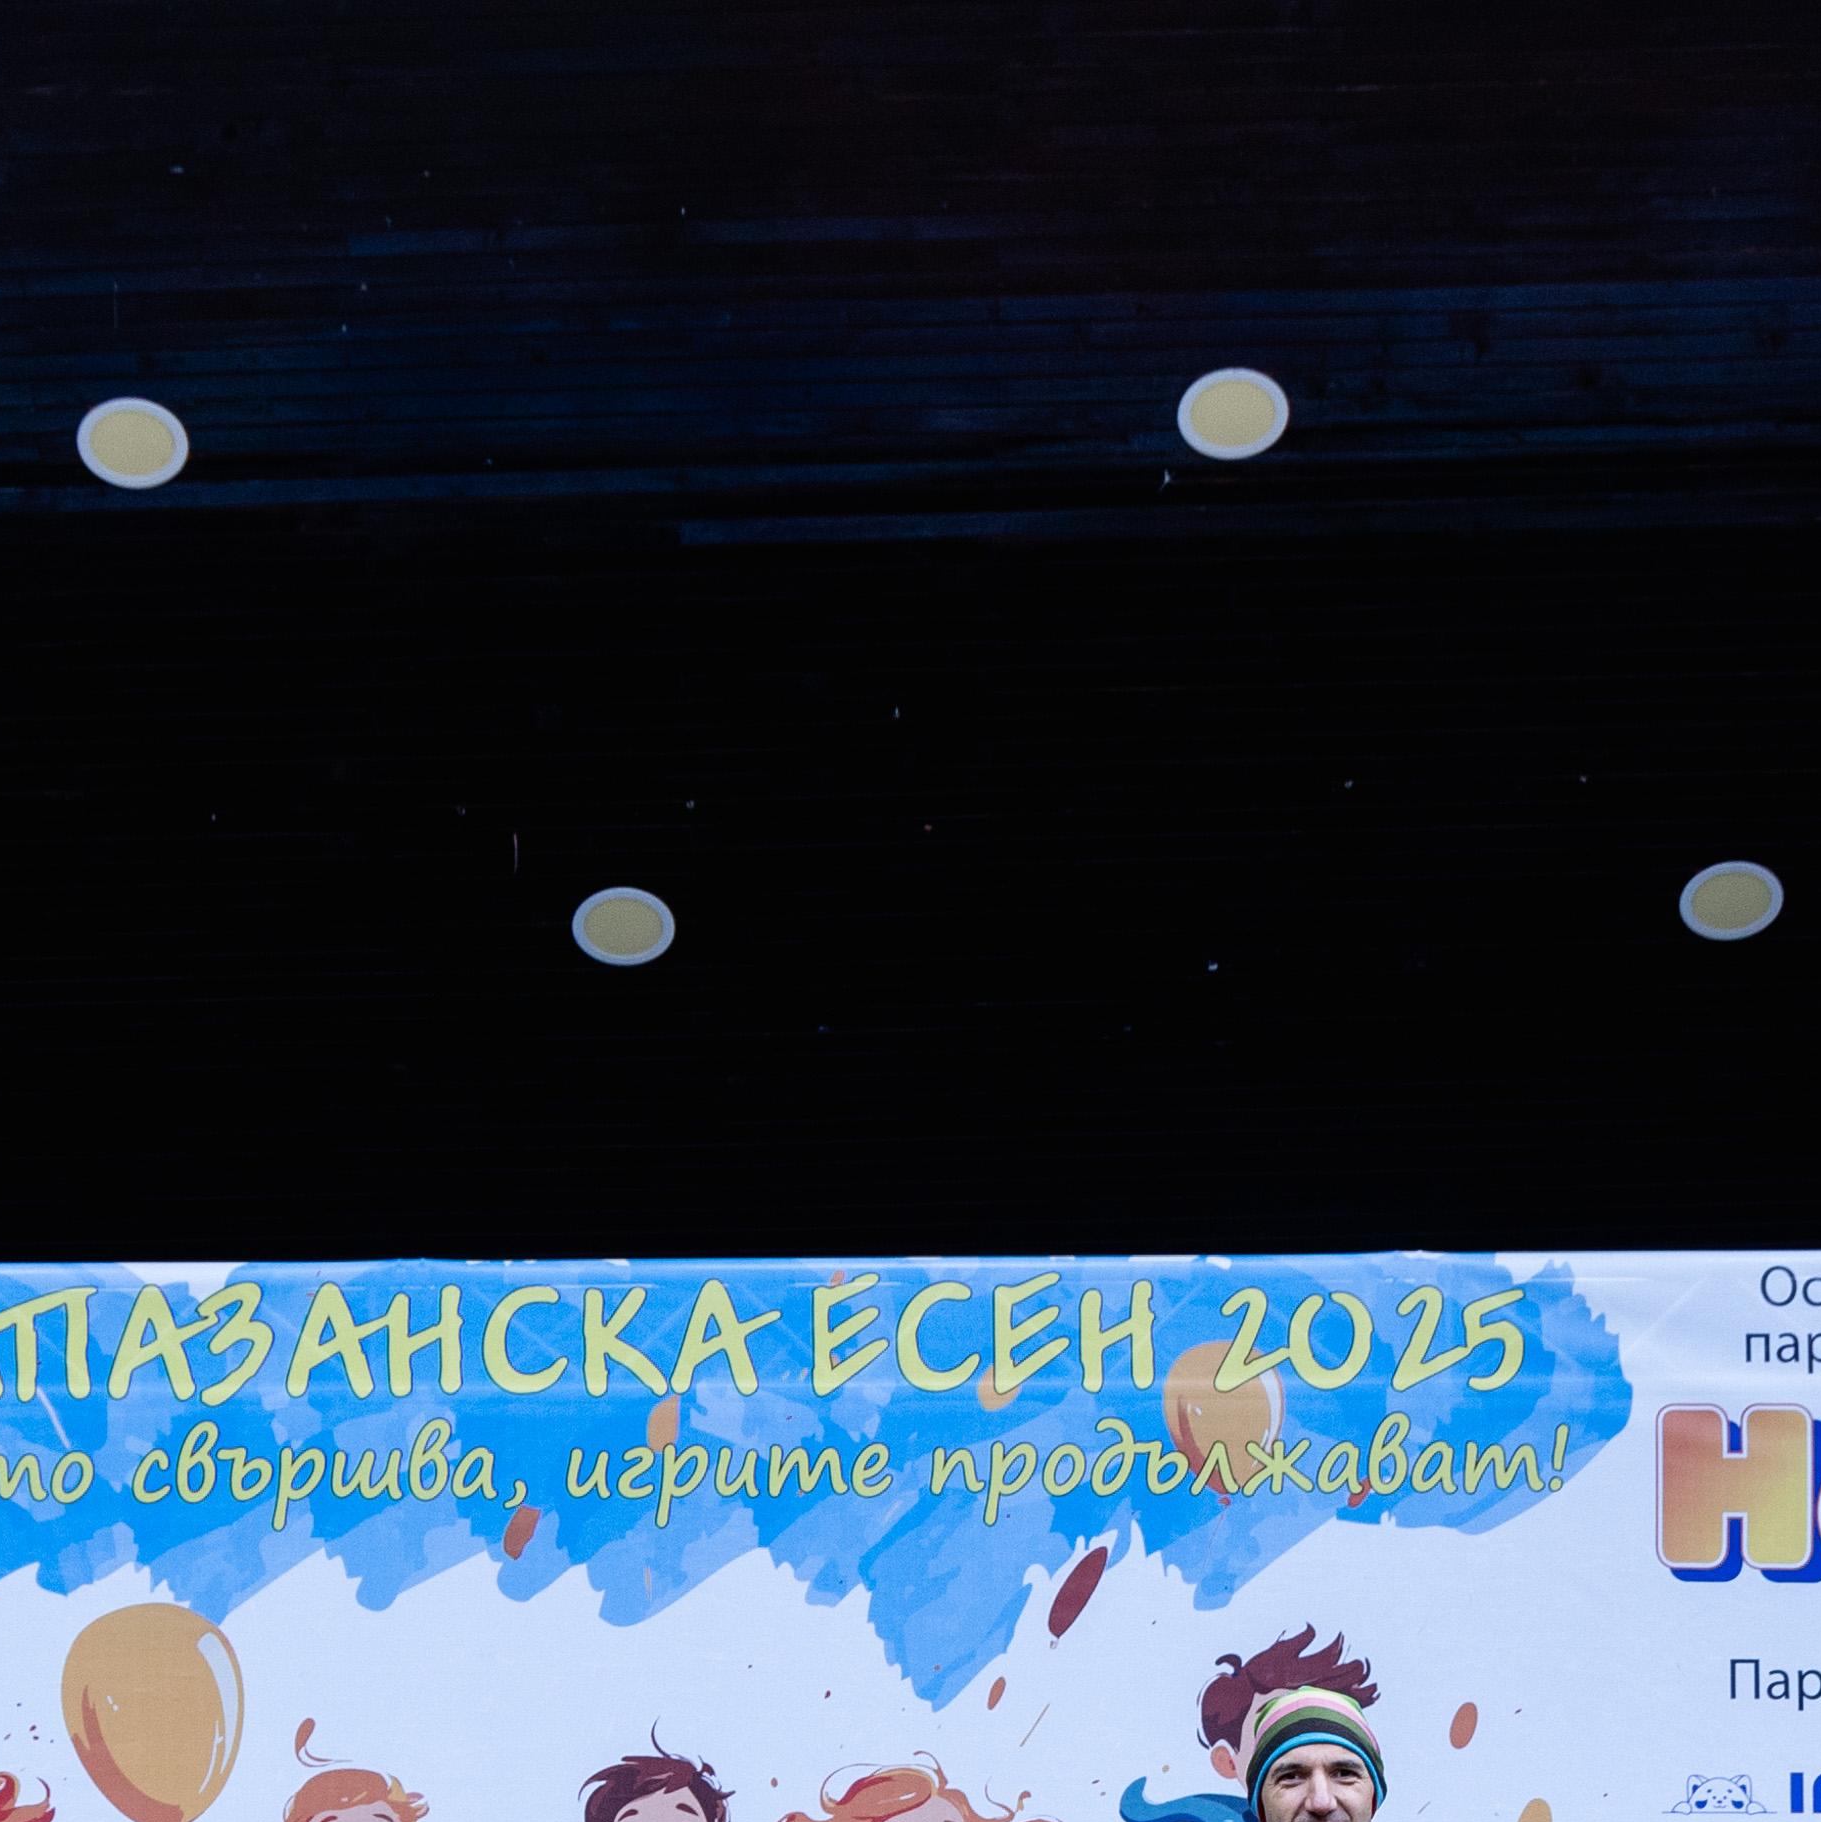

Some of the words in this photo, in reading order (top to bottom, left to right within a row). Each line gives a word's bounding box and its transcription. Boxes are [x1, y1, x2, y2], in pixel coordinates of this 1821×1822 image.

[811, 1272, 1156, 1397] ЕСЕН
[1213, 1285, 1525, 1393] 2025
[132, 1417, 530, 1531] свършва,
[566, 1442, 892, 1529] игрите
[930, 1411, 1570, 1527] продължават!
